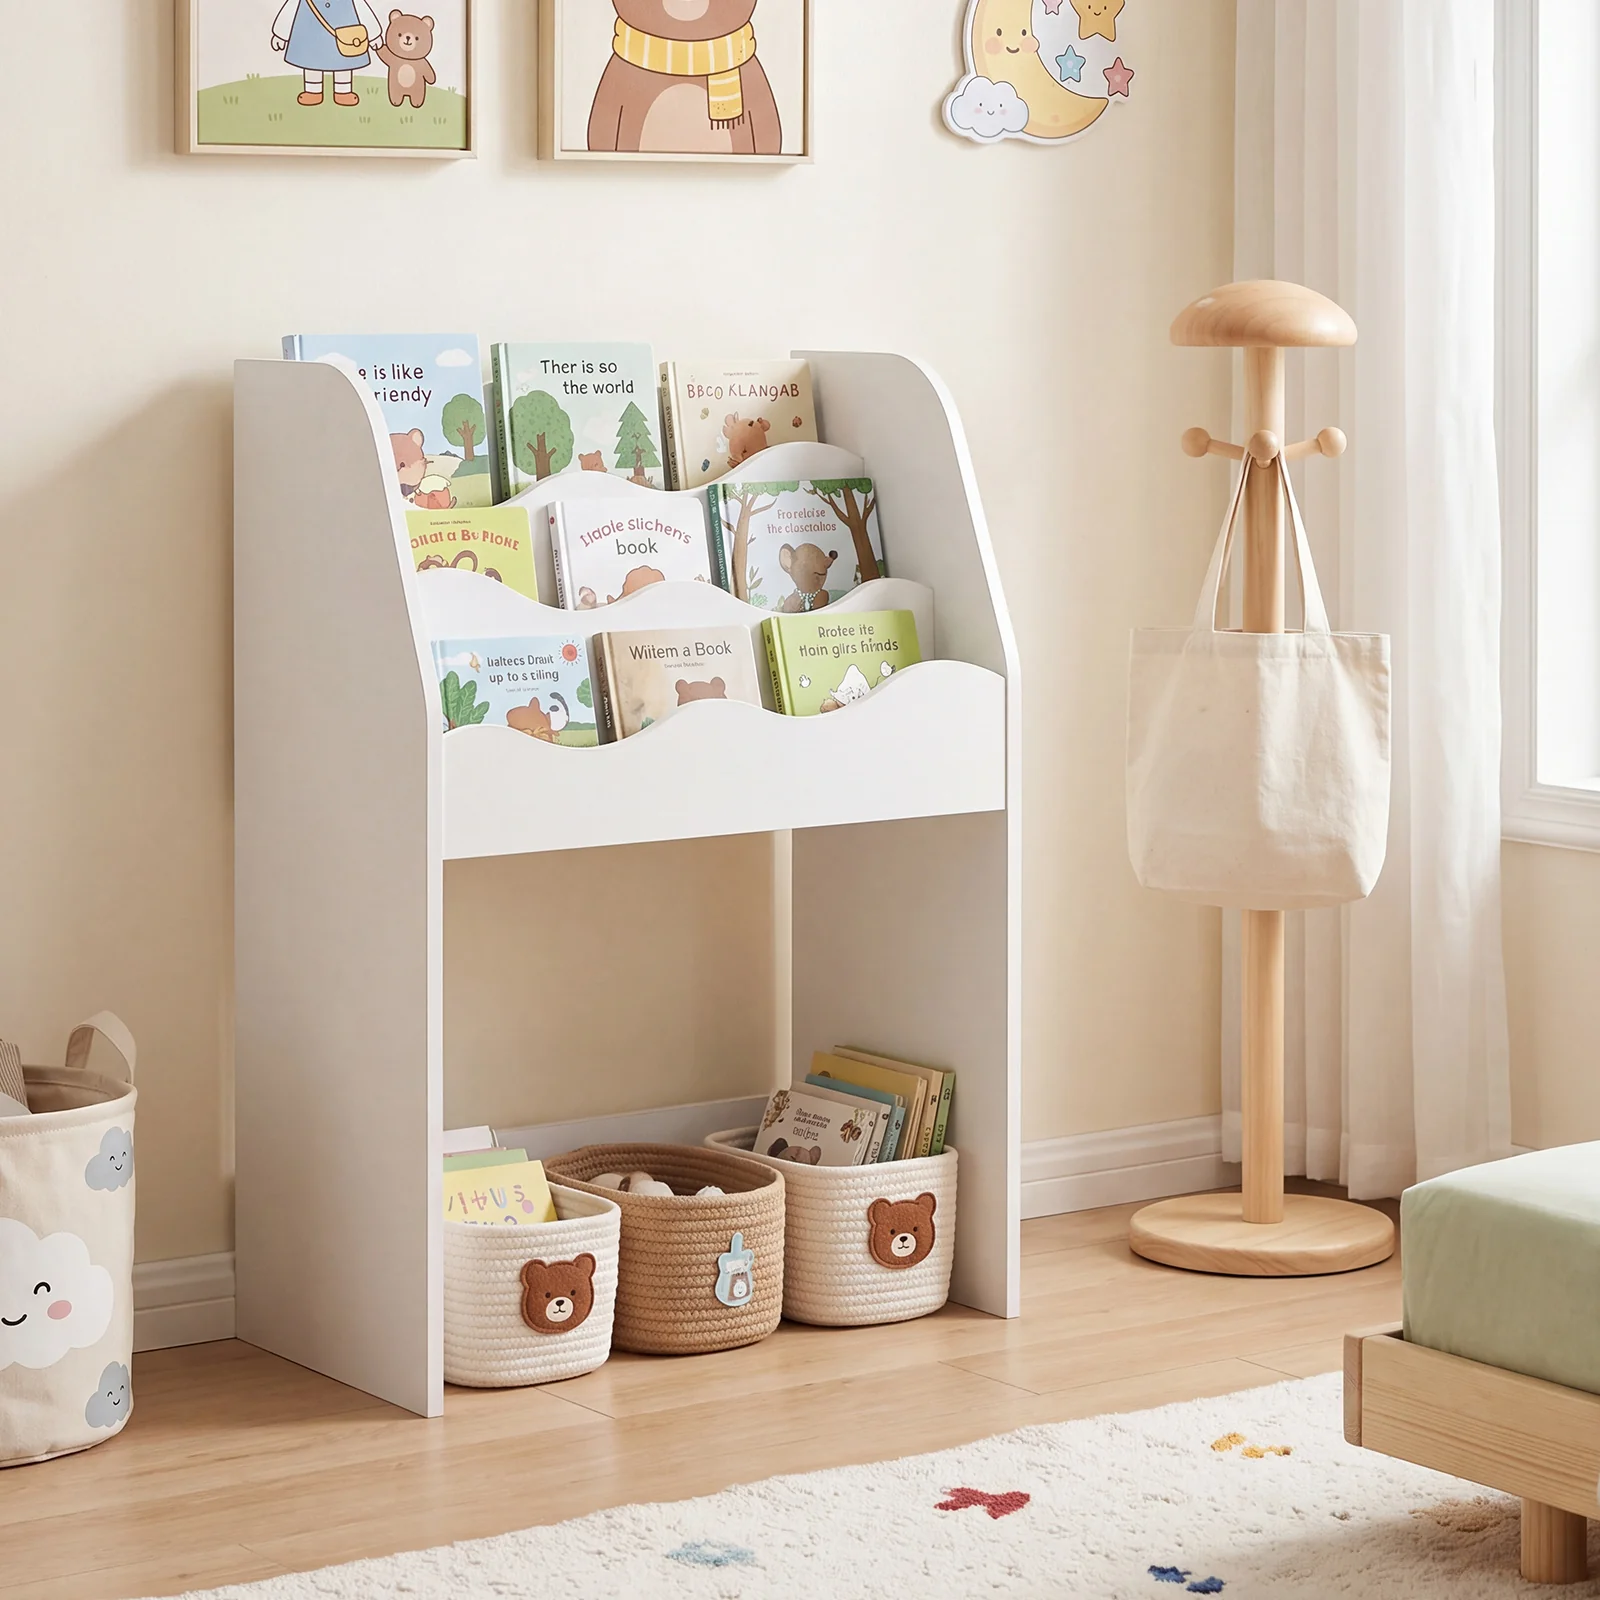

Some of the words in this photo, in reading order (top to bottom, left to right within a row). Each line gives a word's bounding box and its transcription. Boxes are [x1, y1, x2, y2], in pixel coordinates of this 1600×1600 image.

[373, 364, 387, 380] is
[391, 363, 424, 380] like
[540, 359, 577, 374] Ther
[582, 360, 594, 374] is
[599, 362, 618, 374] so
[563, 380, 588, 395] the
[592, 379, 634, 394] world
[767, 522, 783, 534] the
[615, 537, 659, 555] book
[682, 646, 691, 657] a
[694, 641, 732, 656] Book
[489, 673, 504, 685] up
[507, 672, 519, 682] to
